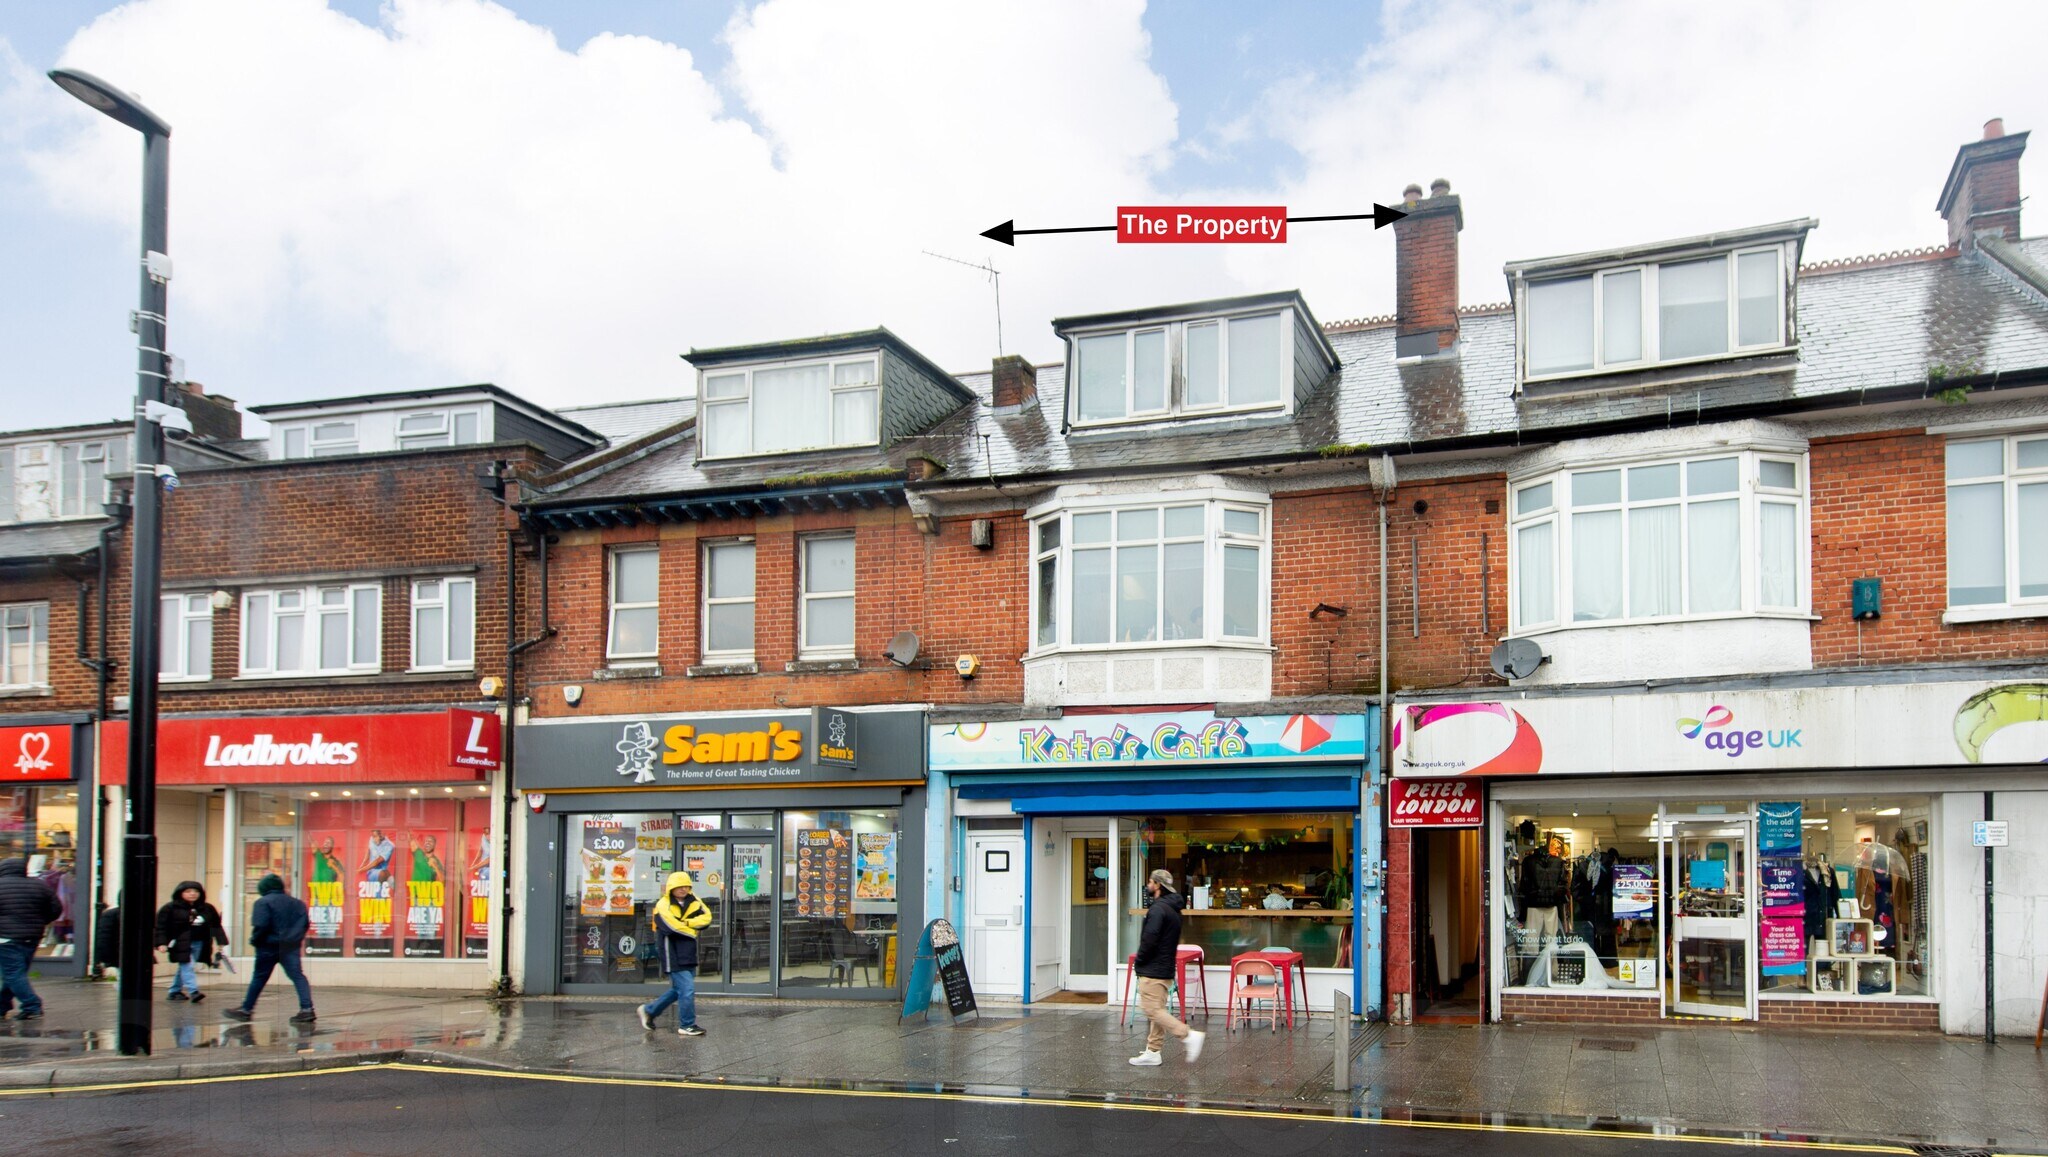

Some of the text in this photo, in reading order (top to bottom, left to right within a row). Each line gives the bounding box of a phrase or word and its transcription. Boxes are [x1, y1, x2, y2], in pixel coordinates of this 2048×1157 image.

[466, 716, 489, 753] L
[662, 721, 802, 765] Sam's
[1019, 717, 1252, 763] Kate's Café
[1705, 729, 1802, 757] age UK
[204, 733, 358, 766] Ladbrokes
[820, 743, 854, 760] Sam's
[456, 755, 497, 766] Ladbrokes
[1403, 760, 1466, 769] www.ageuk.org.uk
[666, 767, 800, 778] The Home of Great Tasting Chicken
[1405, 782, 1467, 798] PETER
[1396, 798, 1477, 815] LONDON
[641, 818, 673, 832] STRAIGH
[1978, 824, 1985, 832] P
[594, 836, 625, 850] £3.00
[359, 881, 381, 898] 2UP
[1615, 880, 1651, 889] £25,000
[1770, 882, 1795, 890] spare?
[308, 882, 344, 906] TWO
[407, 882, 445, 907] TWO
[360, 898, 392, 924] WIN
[407, 906, 444, 924] ARE YA
[1540, 936, 1562, 944] what
[1563, 936, 1572, 944] to
[1572, 934, 1584, 944] do
